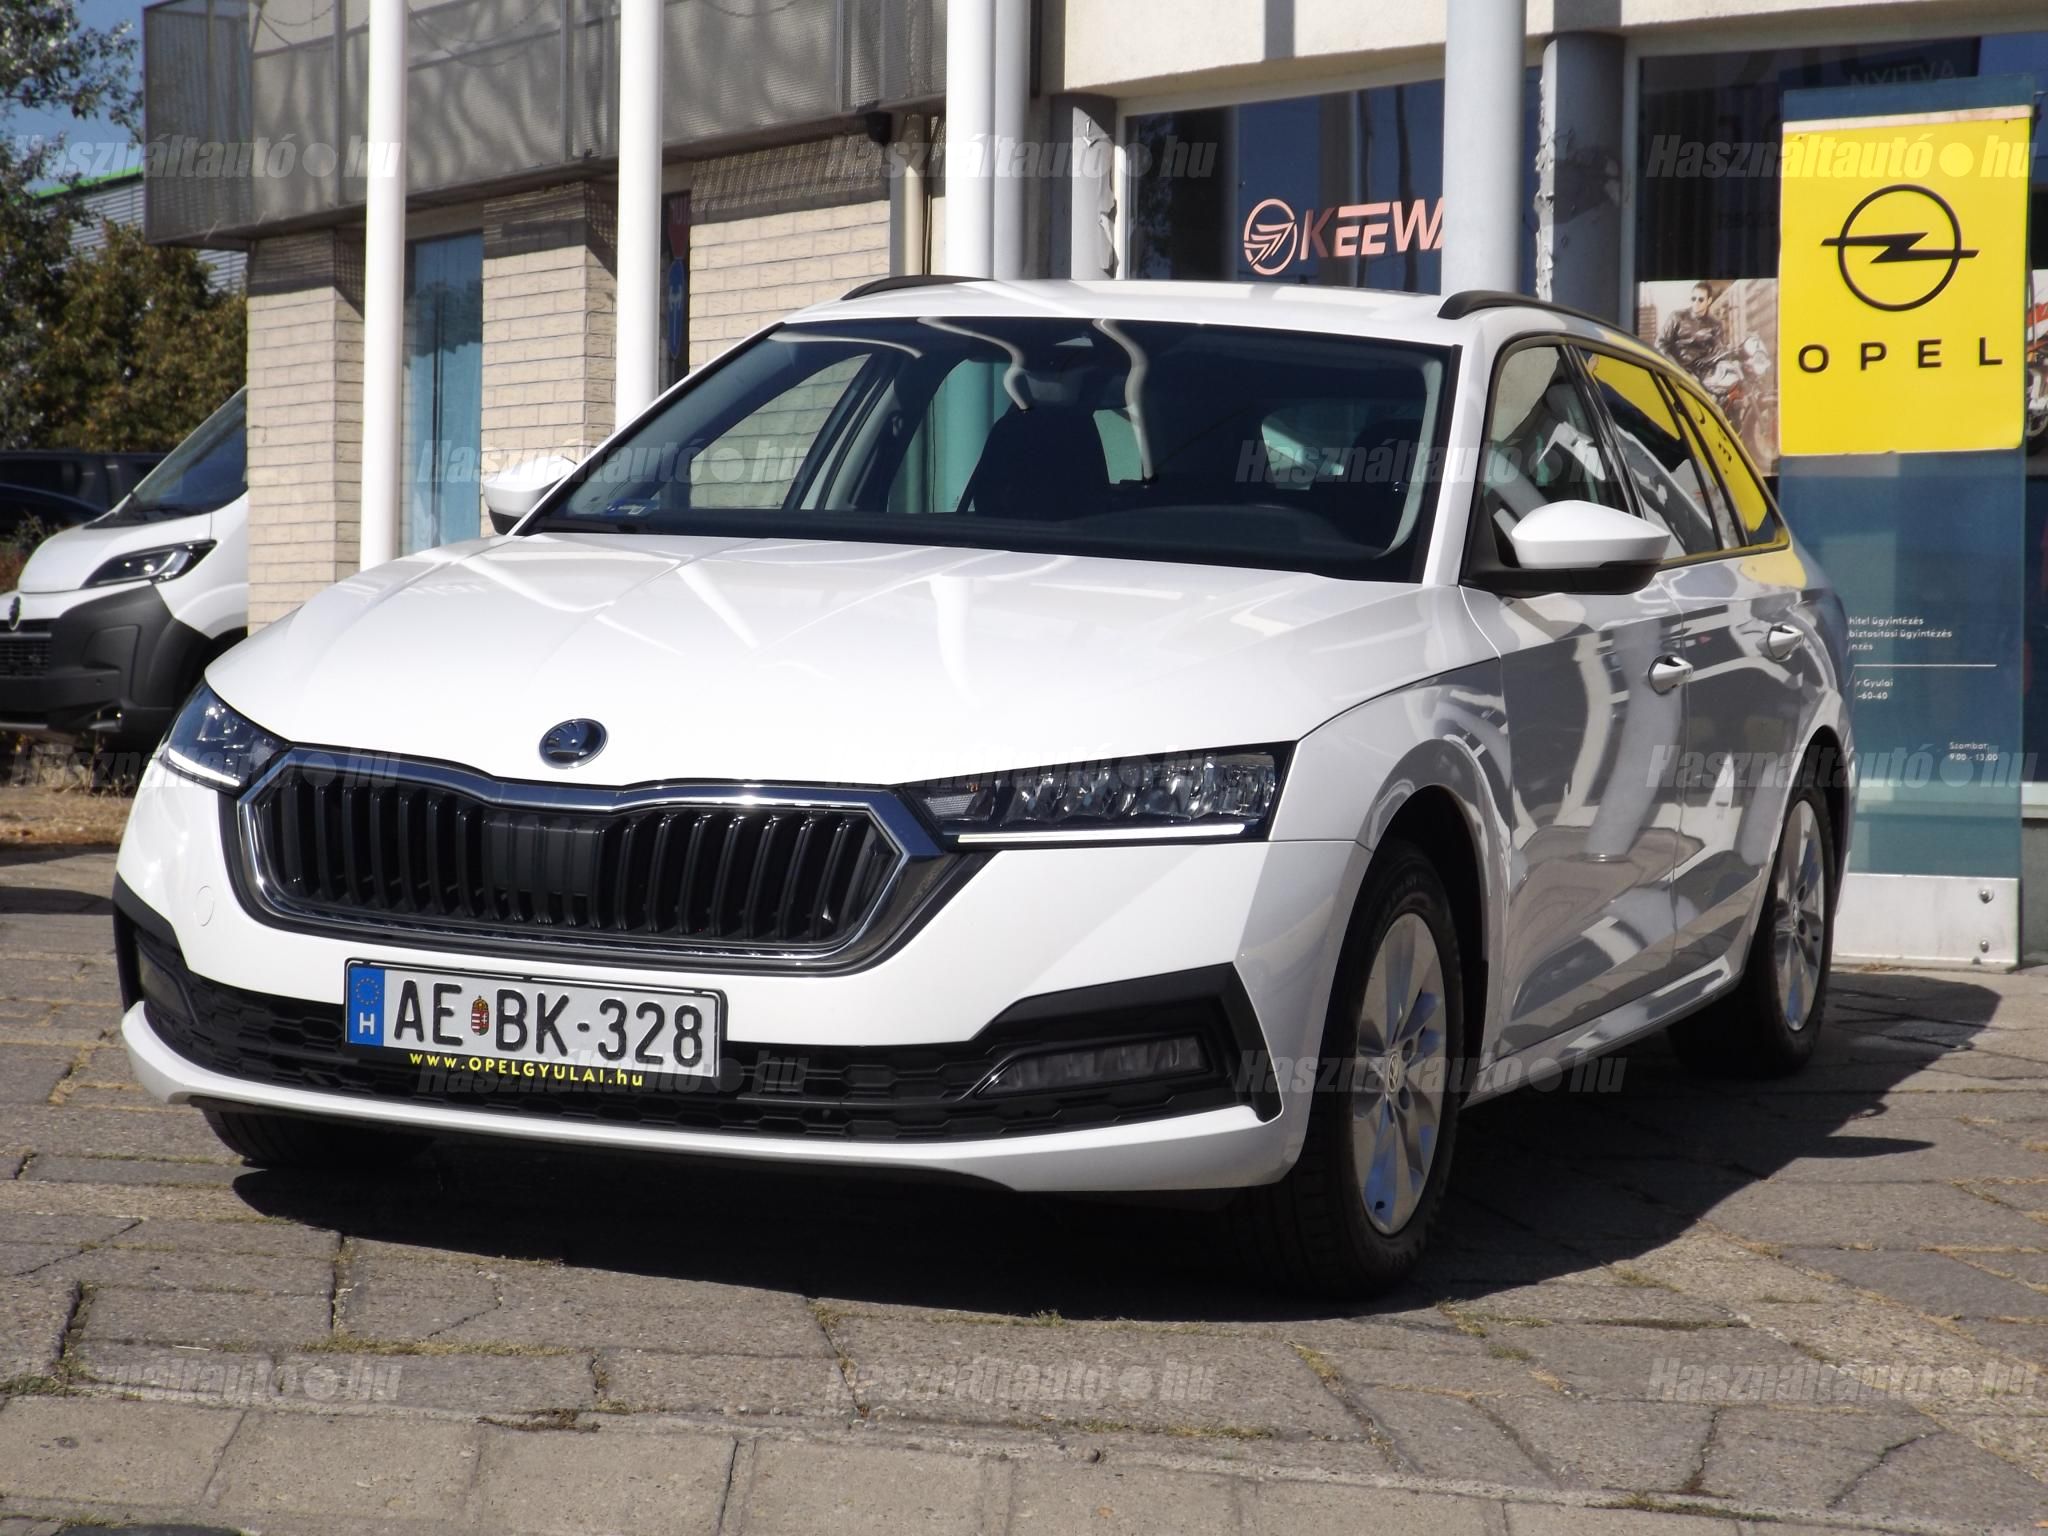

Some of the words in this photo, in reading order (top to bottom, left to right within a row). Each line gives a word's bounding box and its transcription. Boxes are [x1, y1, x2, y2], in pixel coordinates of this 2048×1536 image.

[1299, 196, 1444, 261] KEEW
[1797, 336, 2004, 374] OPEL
[1848, 615, 1870, 625] hitel
[1872, 615, 1925, 627] ügyintézés
[1848, 629, 1898, 639] biztosítási
[1900, 628, 1953, 640] ügyintézés
[1856, 691, 1889, 700] -60-40
[1863, 678, 1894, 689] Gyulai
[358, 1012, 375, 1036] H
[394, 979, 463, 1047] AE
[495, 988, 704, 1068] BK-328
[409, 1052, 644, 1087] www.OPELGYULAI.hu
